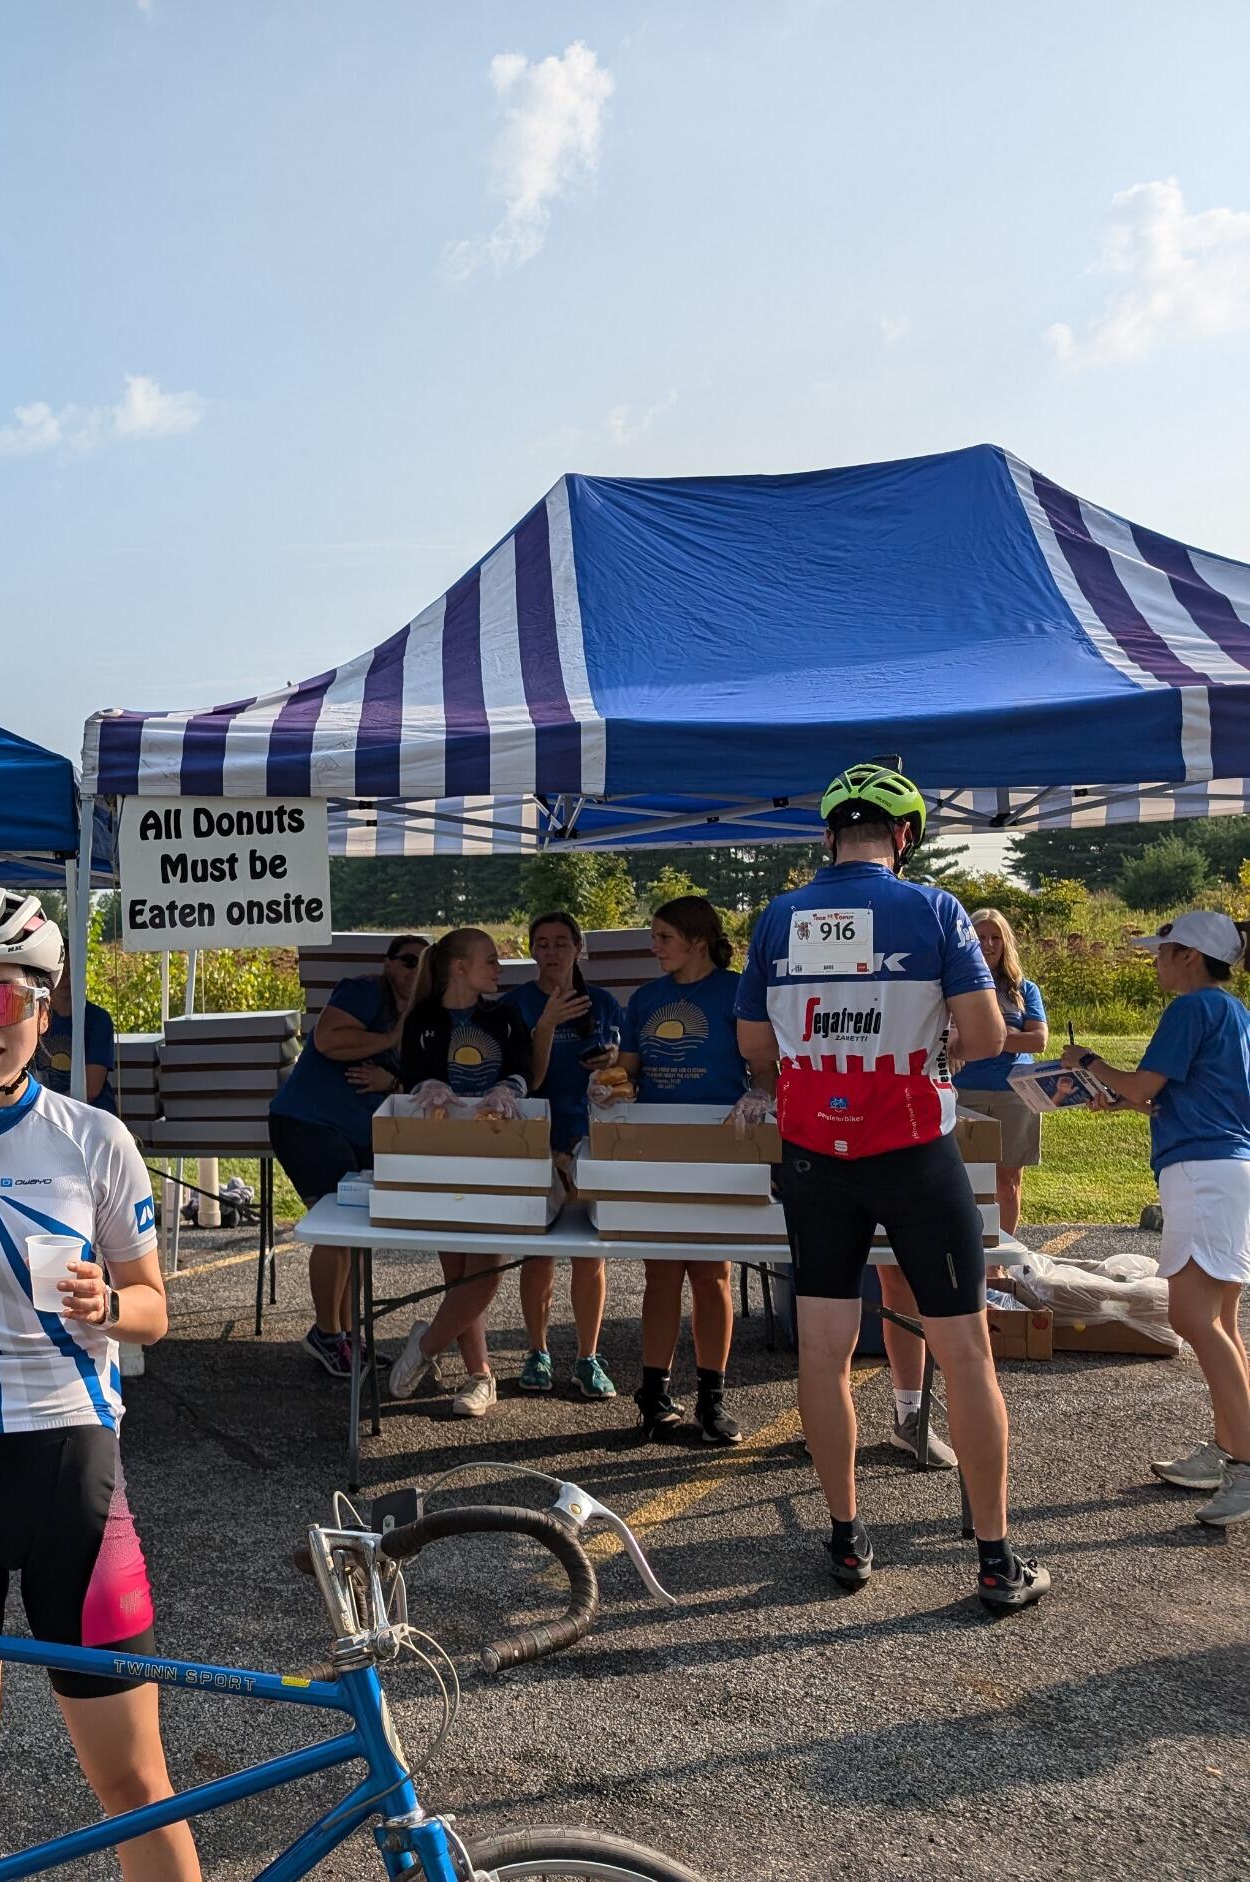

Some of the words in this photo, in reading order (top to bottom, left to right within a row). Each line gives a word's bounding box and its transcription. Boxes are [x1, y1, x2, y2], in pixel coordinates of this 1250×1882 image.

[140, 808, 182, 841] All
[193, 805, 305, 839] Donuts
[161, 852, 239, 884] Must
[249, 849, 288, 880] be
[129, 899, 215, 930] Eaten
[226, 893, 324, 926] onsite
[819, 920, 856, 942] 916
[772, 952, 912, 978] TK
[802, 997, 882, 1042] Segafredo
[113, 1659, 178, 1681] TWINN
[184, 1669, 256, 1692] SPORT
